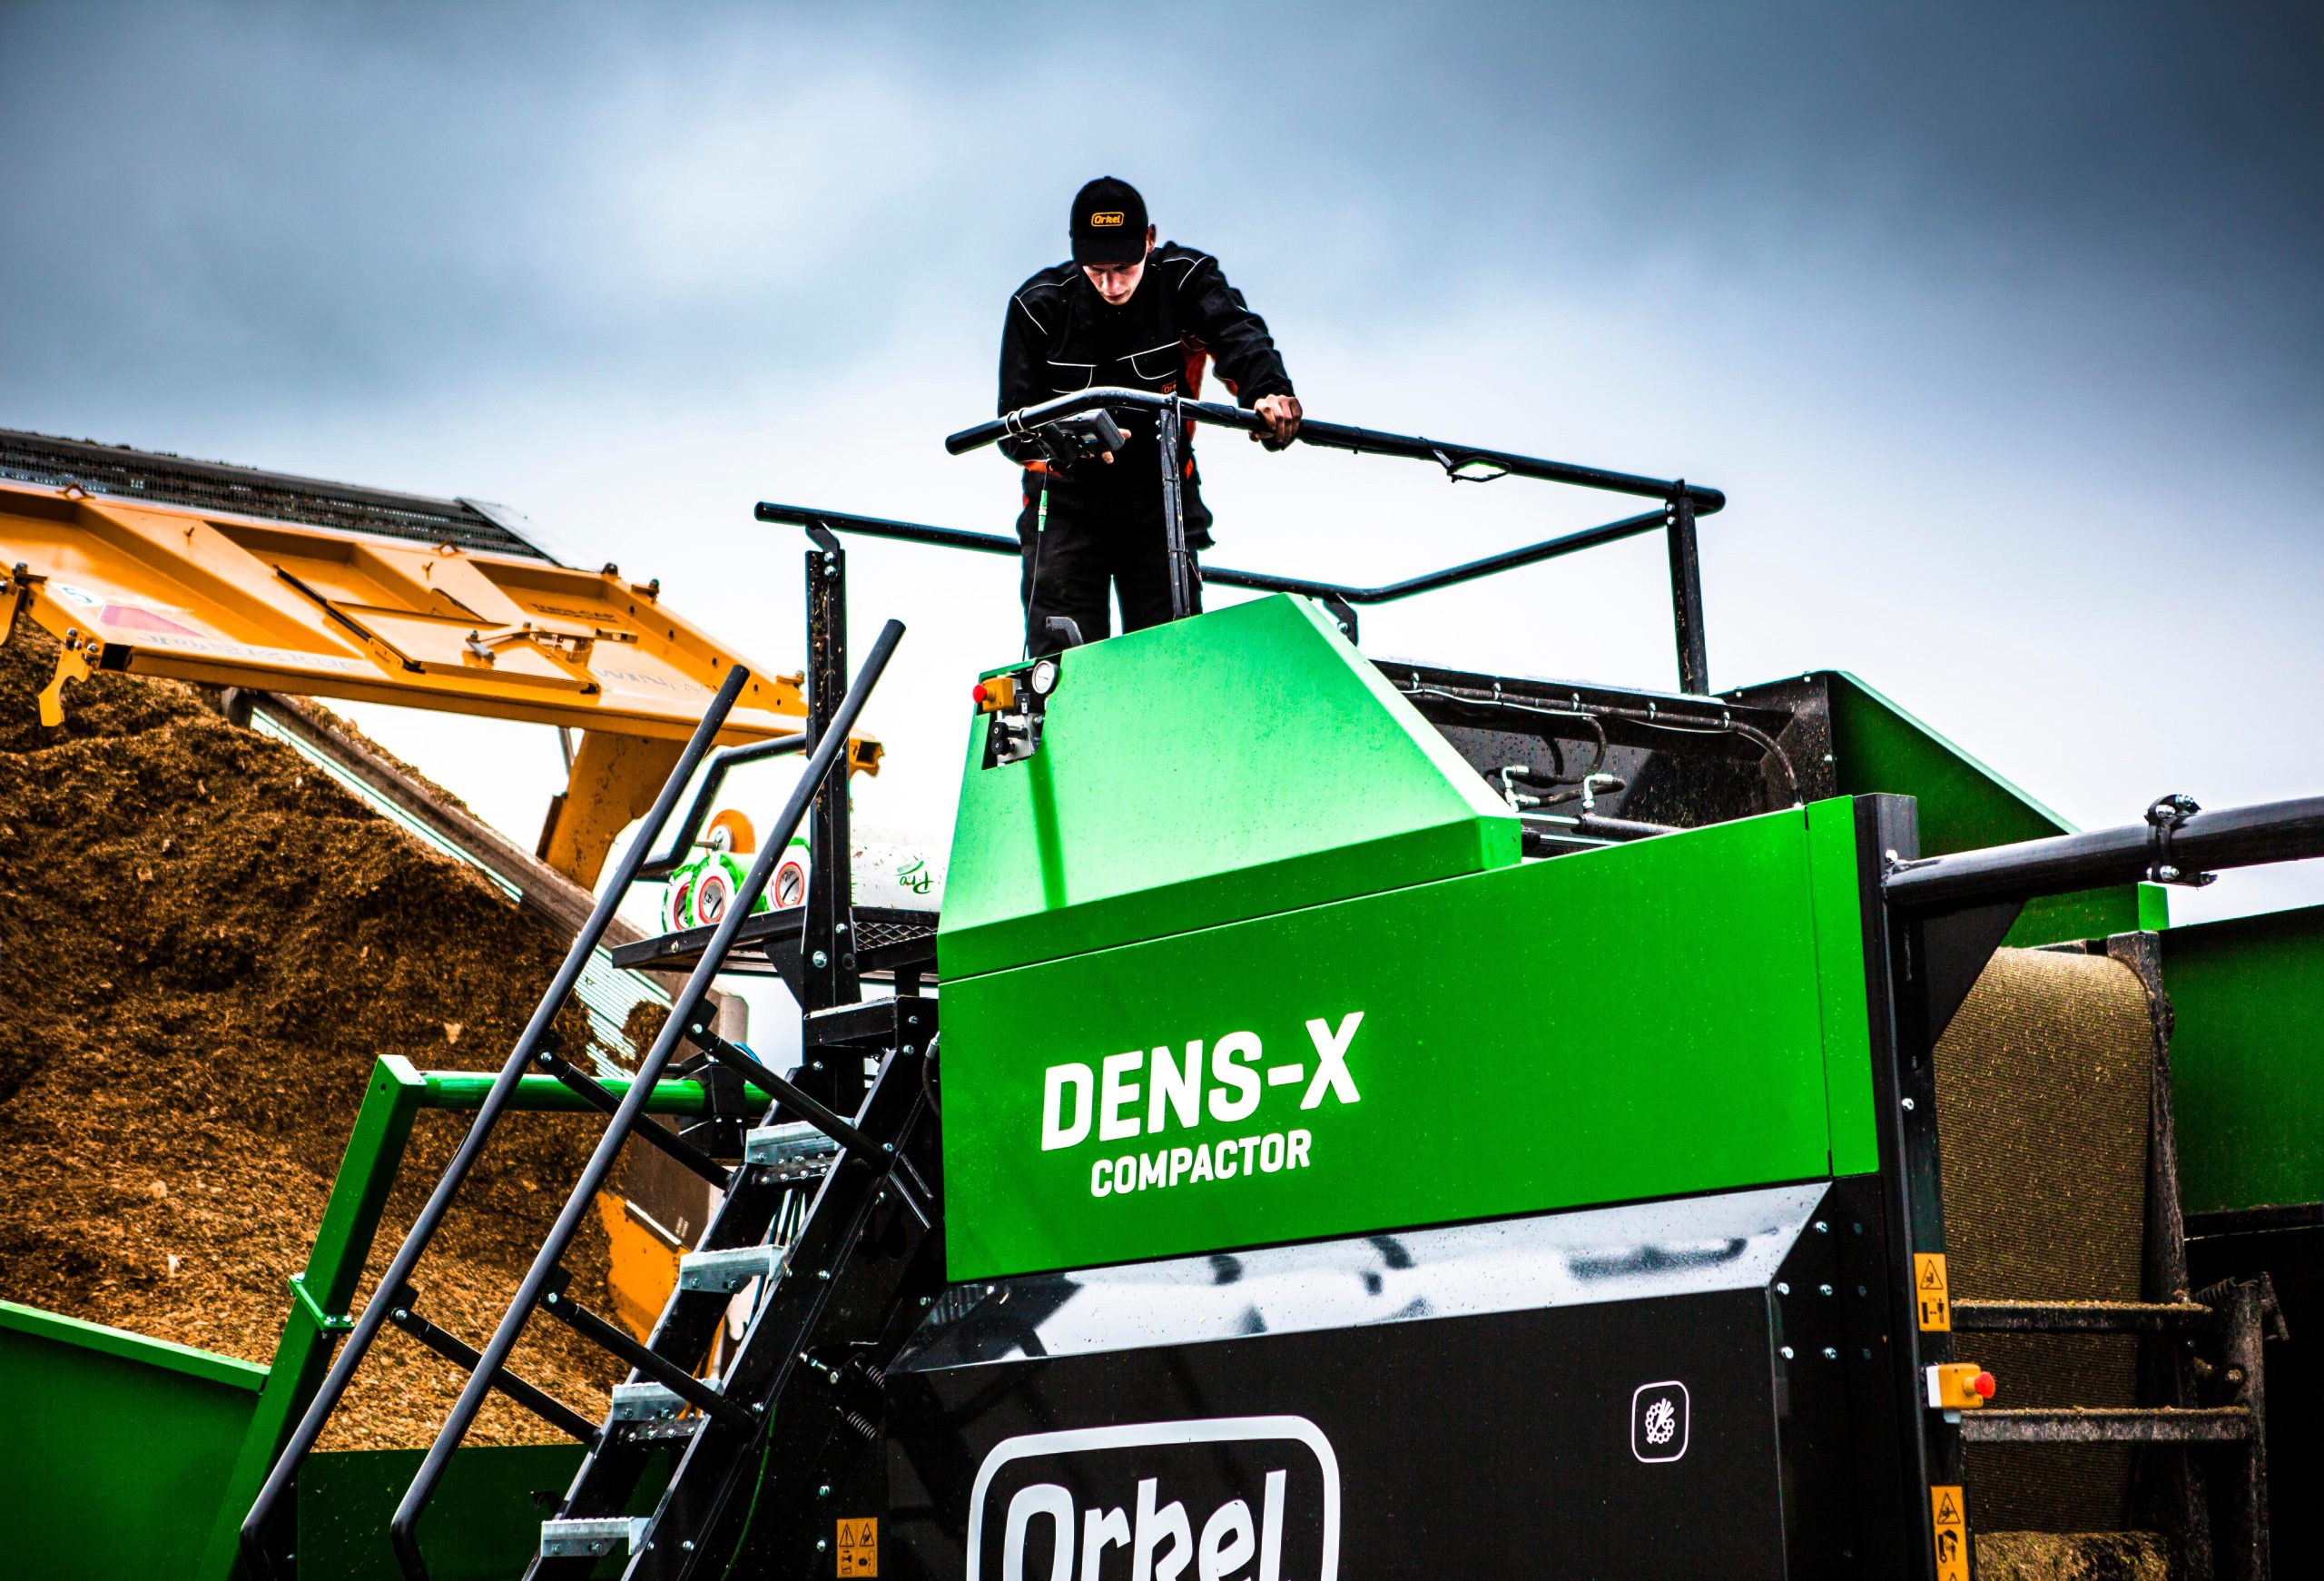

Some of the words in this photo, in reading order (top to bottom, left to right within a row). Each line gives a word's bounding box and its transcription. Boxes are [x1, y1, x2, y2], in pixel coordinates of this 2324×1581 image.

[1094, 214, 1122, 224] Orkel
[61, 587, 93, 604] 5
[899, 870, 934, 894] Pro
[1042, 1012, 1364, 1151] DENS-X
[1091, 1129, 1312, 1198] COMPACTOR
[1002, 1468, 1288, 1581] Orkel
